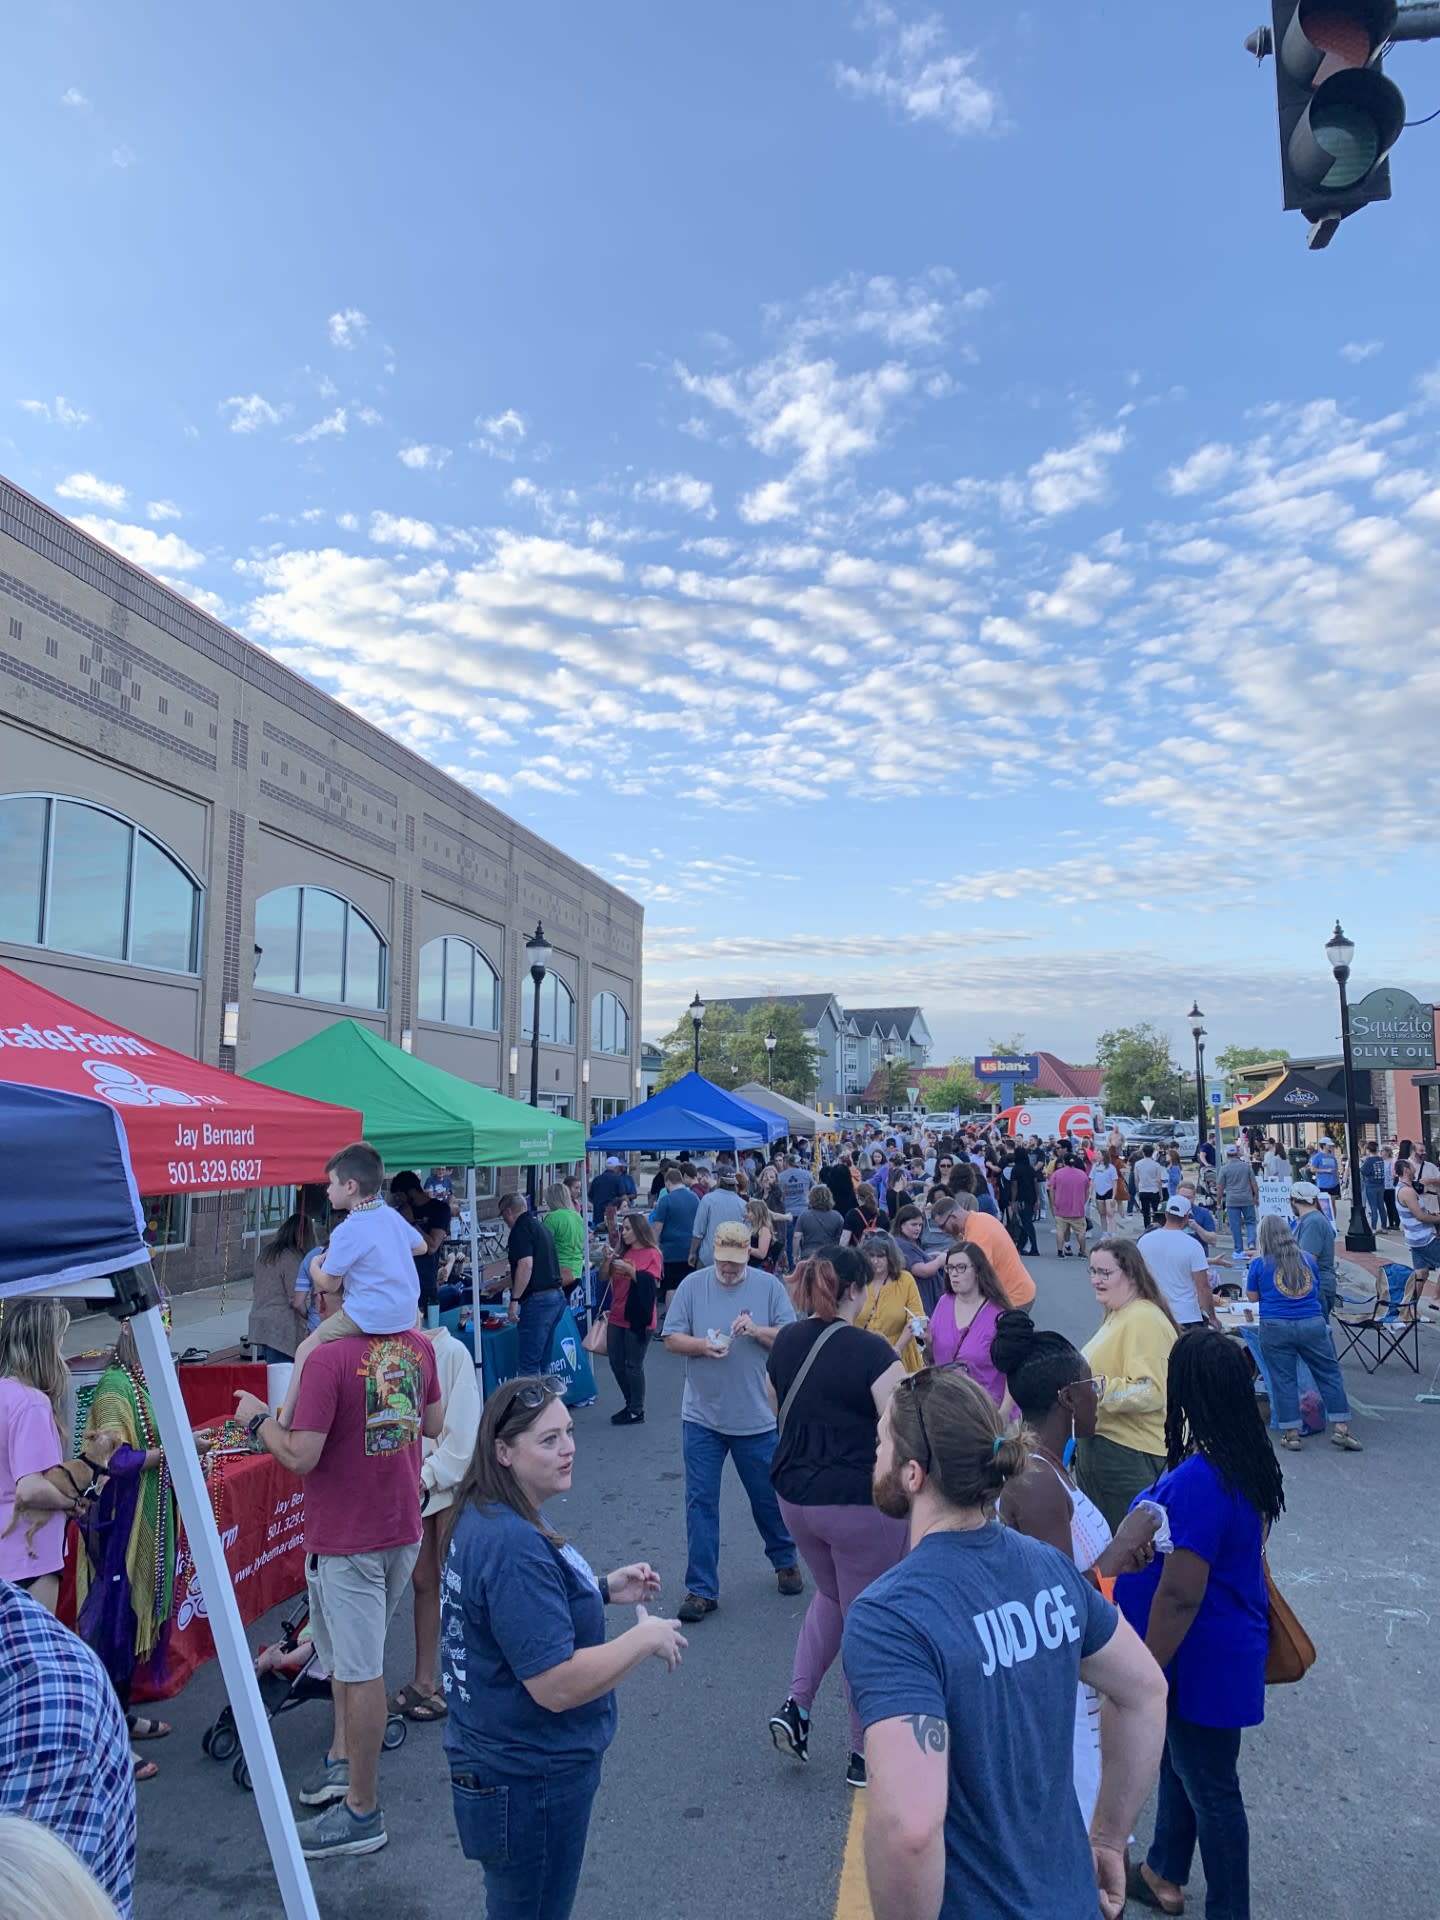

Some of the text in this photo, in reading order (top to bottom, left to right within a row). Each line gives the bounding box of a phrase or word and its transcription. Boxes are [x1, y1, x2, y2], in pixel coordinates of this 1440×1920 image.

[0, 1023, 157, 1056] tateFarm
[1346, 1016, 1432, 1039] Squizito
[1353, 1047, 1432, 1057] OLIVE OIL
[175, 1124, 255, 1150] Jay Bernard
[168, 1160, 262, 1185] 501.329.6827
[274, 1500, 290, 1515] Jay
[267, 1510, 304, 1541] 501.329.6
[234, 1533, 304, 1584] www.jybernardins
[973, 1584, 1081, 1677] JUDGE
